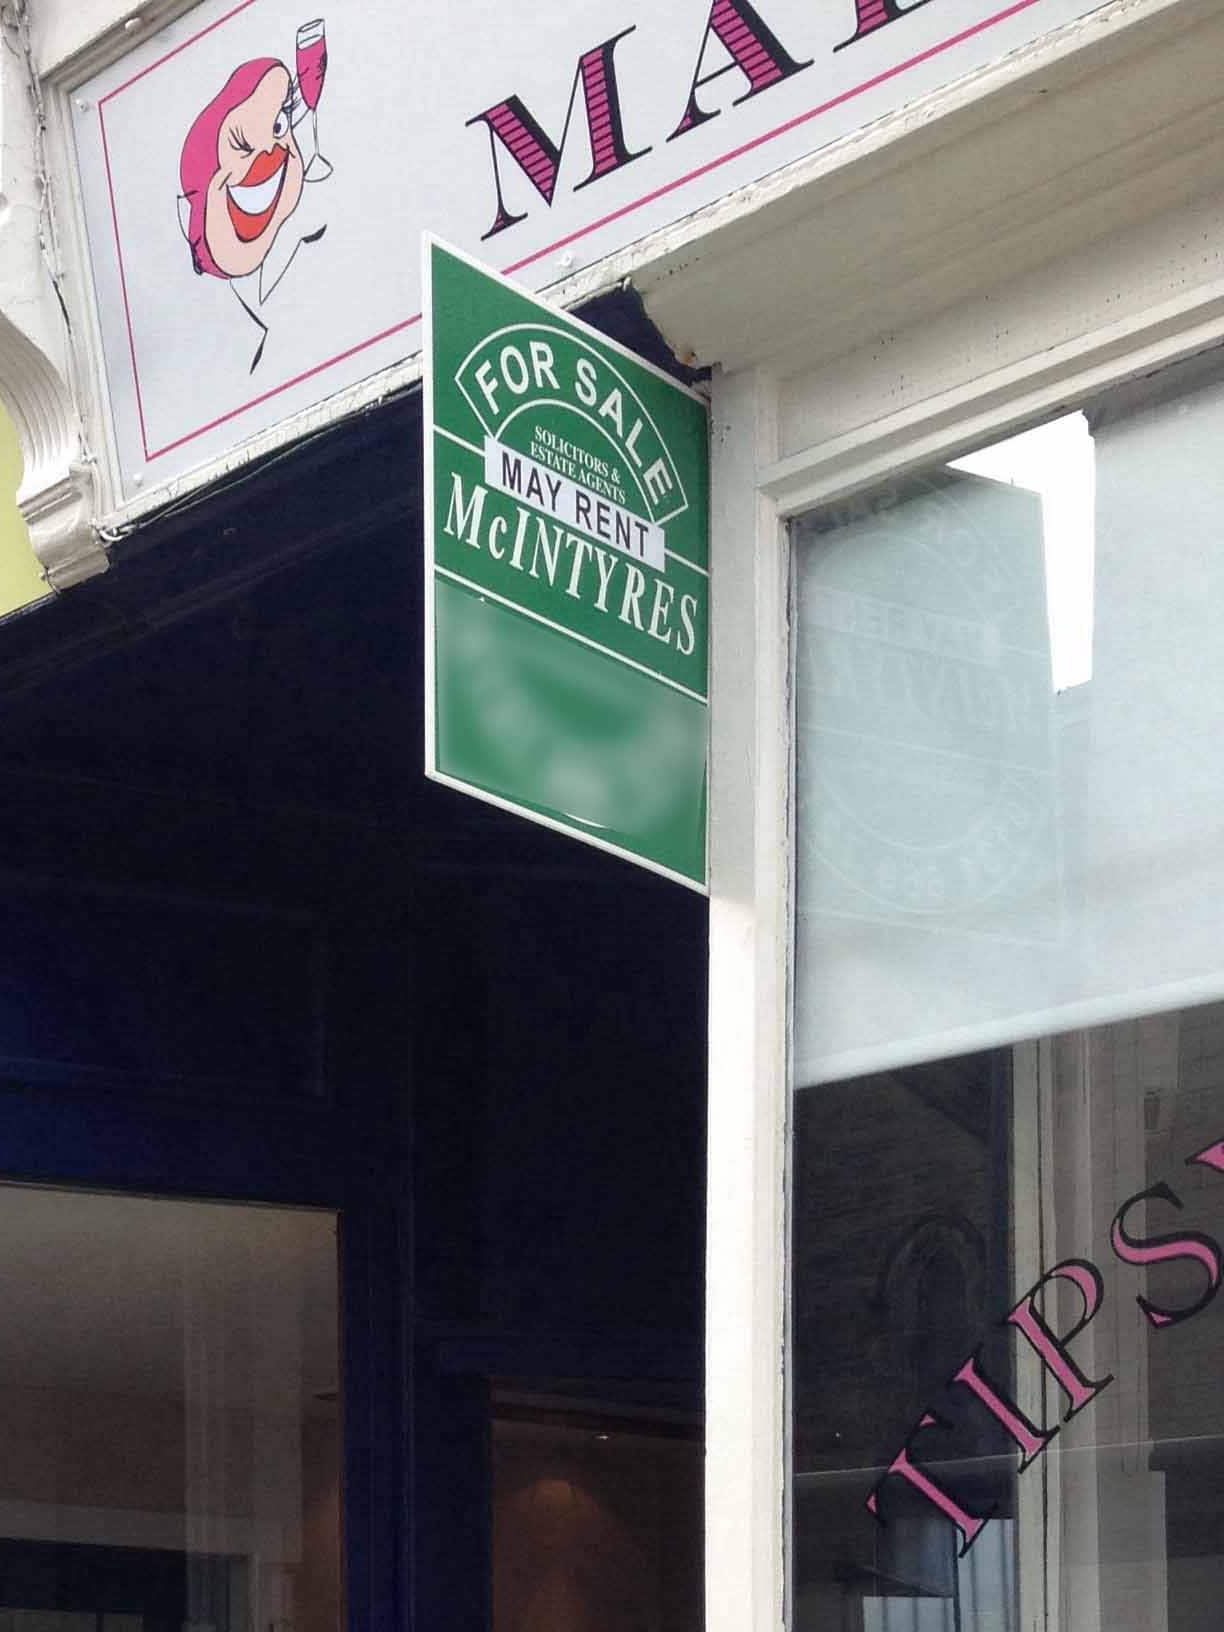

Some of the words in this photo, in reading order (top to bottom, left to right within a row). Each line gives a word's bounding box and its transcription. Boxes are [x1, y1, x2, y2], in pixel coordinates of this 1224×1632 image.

[466, 0, 931, 241] MA
[475, 341, 561, 415] FOR
[576, 358, 673, 505] SALE
[501, 451, 563, 513] MAY
[576, 491, 650, 558] RENT
[530, 441, 576, 477] ESTATE
[577, 466, 626, 505] AGENTS
[534, 425, 610, 480] SOLICITORS
[610, 468, 621, 484] &
[443, 472, 697, 656] McINTYRES
[866, 1138, 1224, 1558] TIPS
